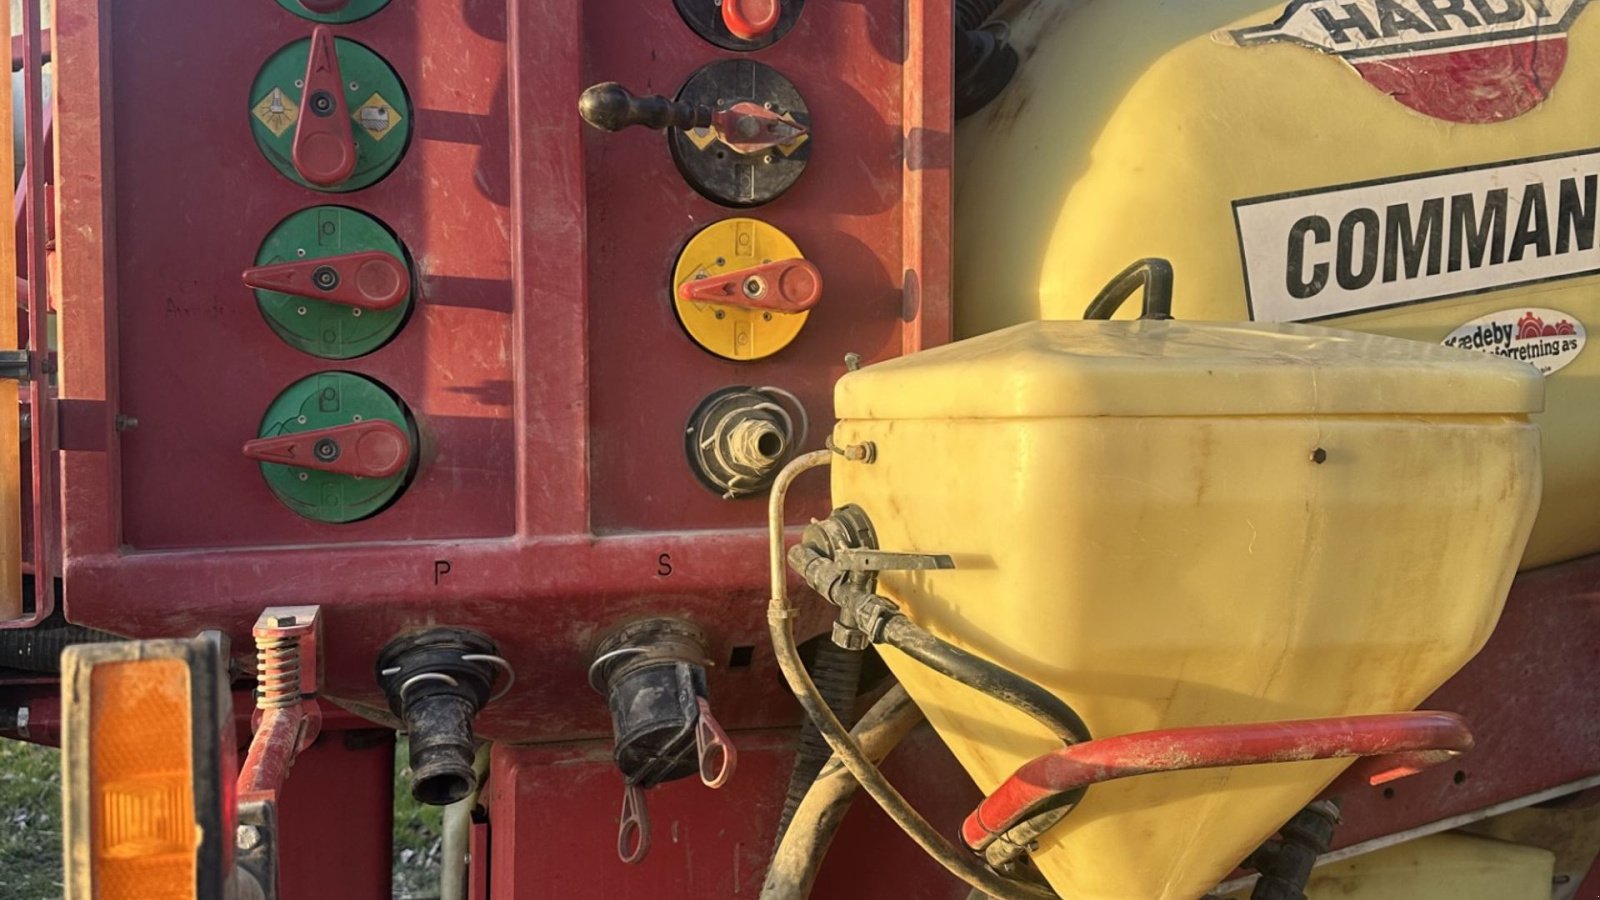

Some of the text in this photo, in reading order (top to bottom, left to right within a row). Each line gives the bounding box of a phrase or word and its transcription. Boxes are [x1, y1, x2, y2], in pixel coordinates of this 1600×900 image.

[1286, 173, 1600, 299] COMMAN
[434, 560, 451, 586] P
[657, 553, 673, 576] S
